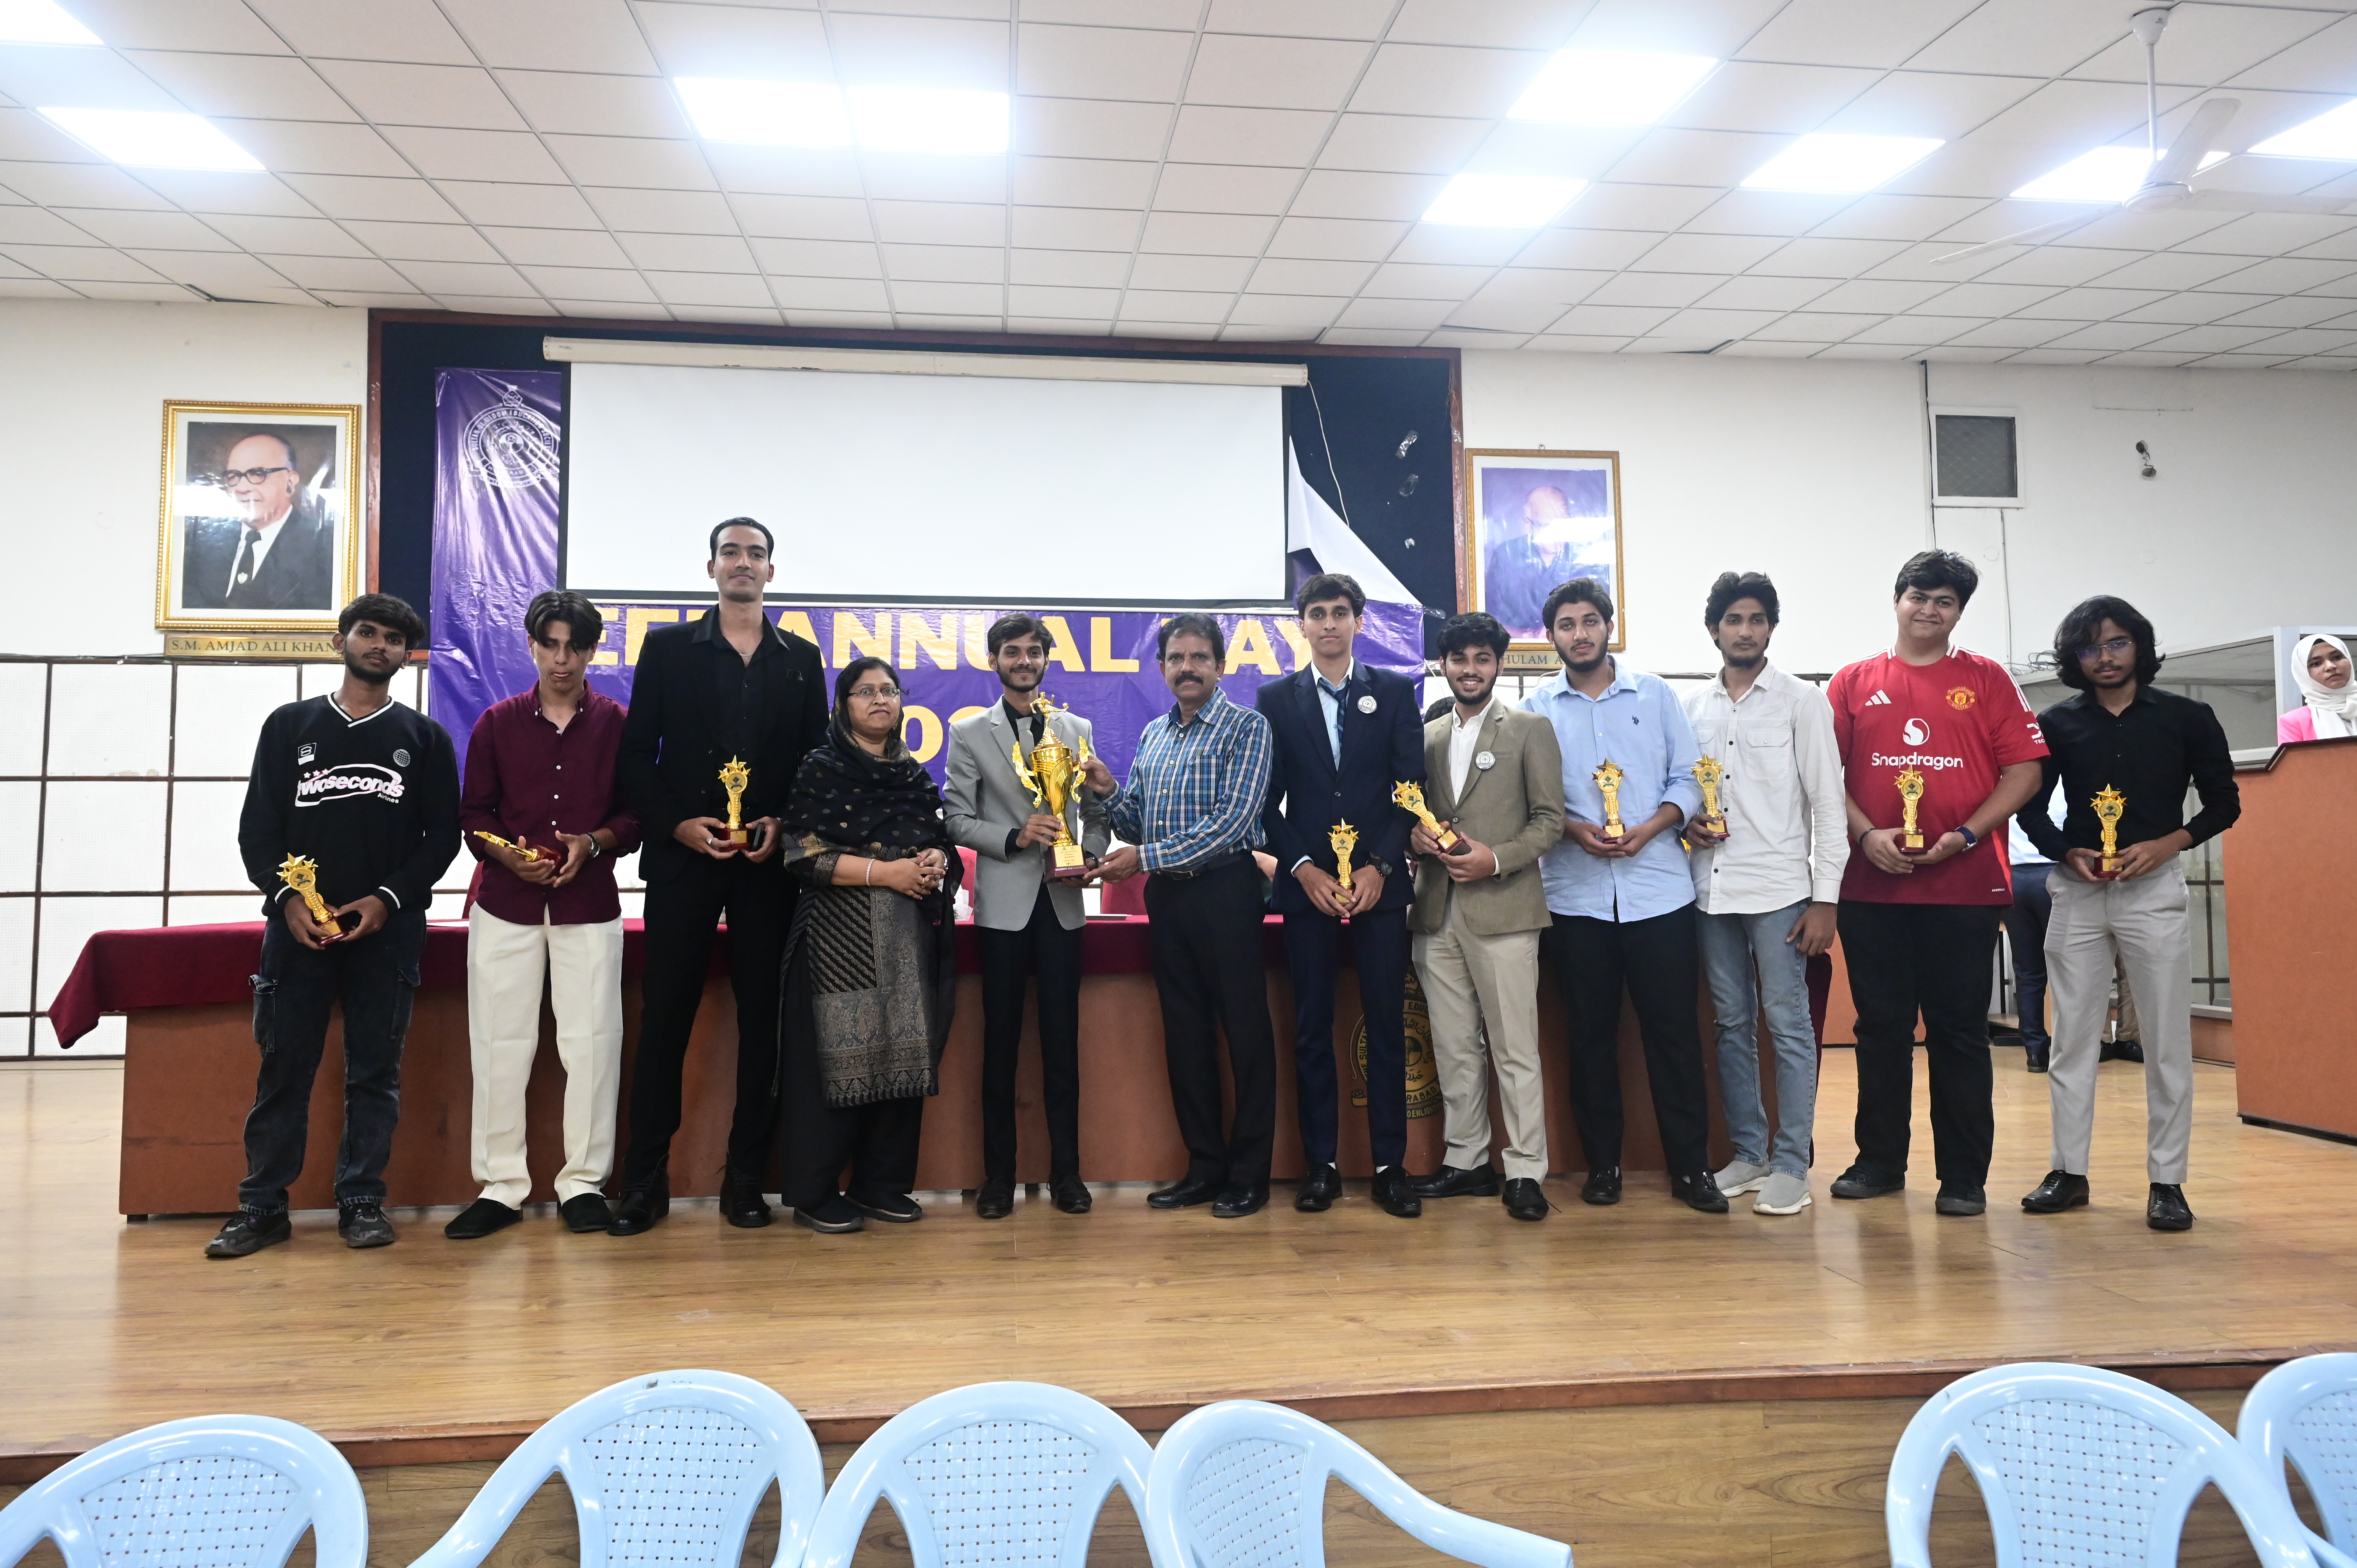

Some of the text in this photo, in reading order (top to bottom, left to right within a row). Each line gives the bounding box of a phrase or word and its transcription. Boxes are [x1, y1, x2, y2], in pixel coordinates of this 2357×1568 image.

[172, 640, 200, 650] S.M.
[205, 640, 258, 652] AMJAD
[262, 641, 287, 652] ALI
[1504, 654, 1548, 664] HULAM
[1871, 752, 1963, 770] Snapdragon
[377, 793, 399, 803] Airlines
[1408, 1002, 1428, 1013] EDUC
[1406, 1086, 1436, 1102] RABAD
